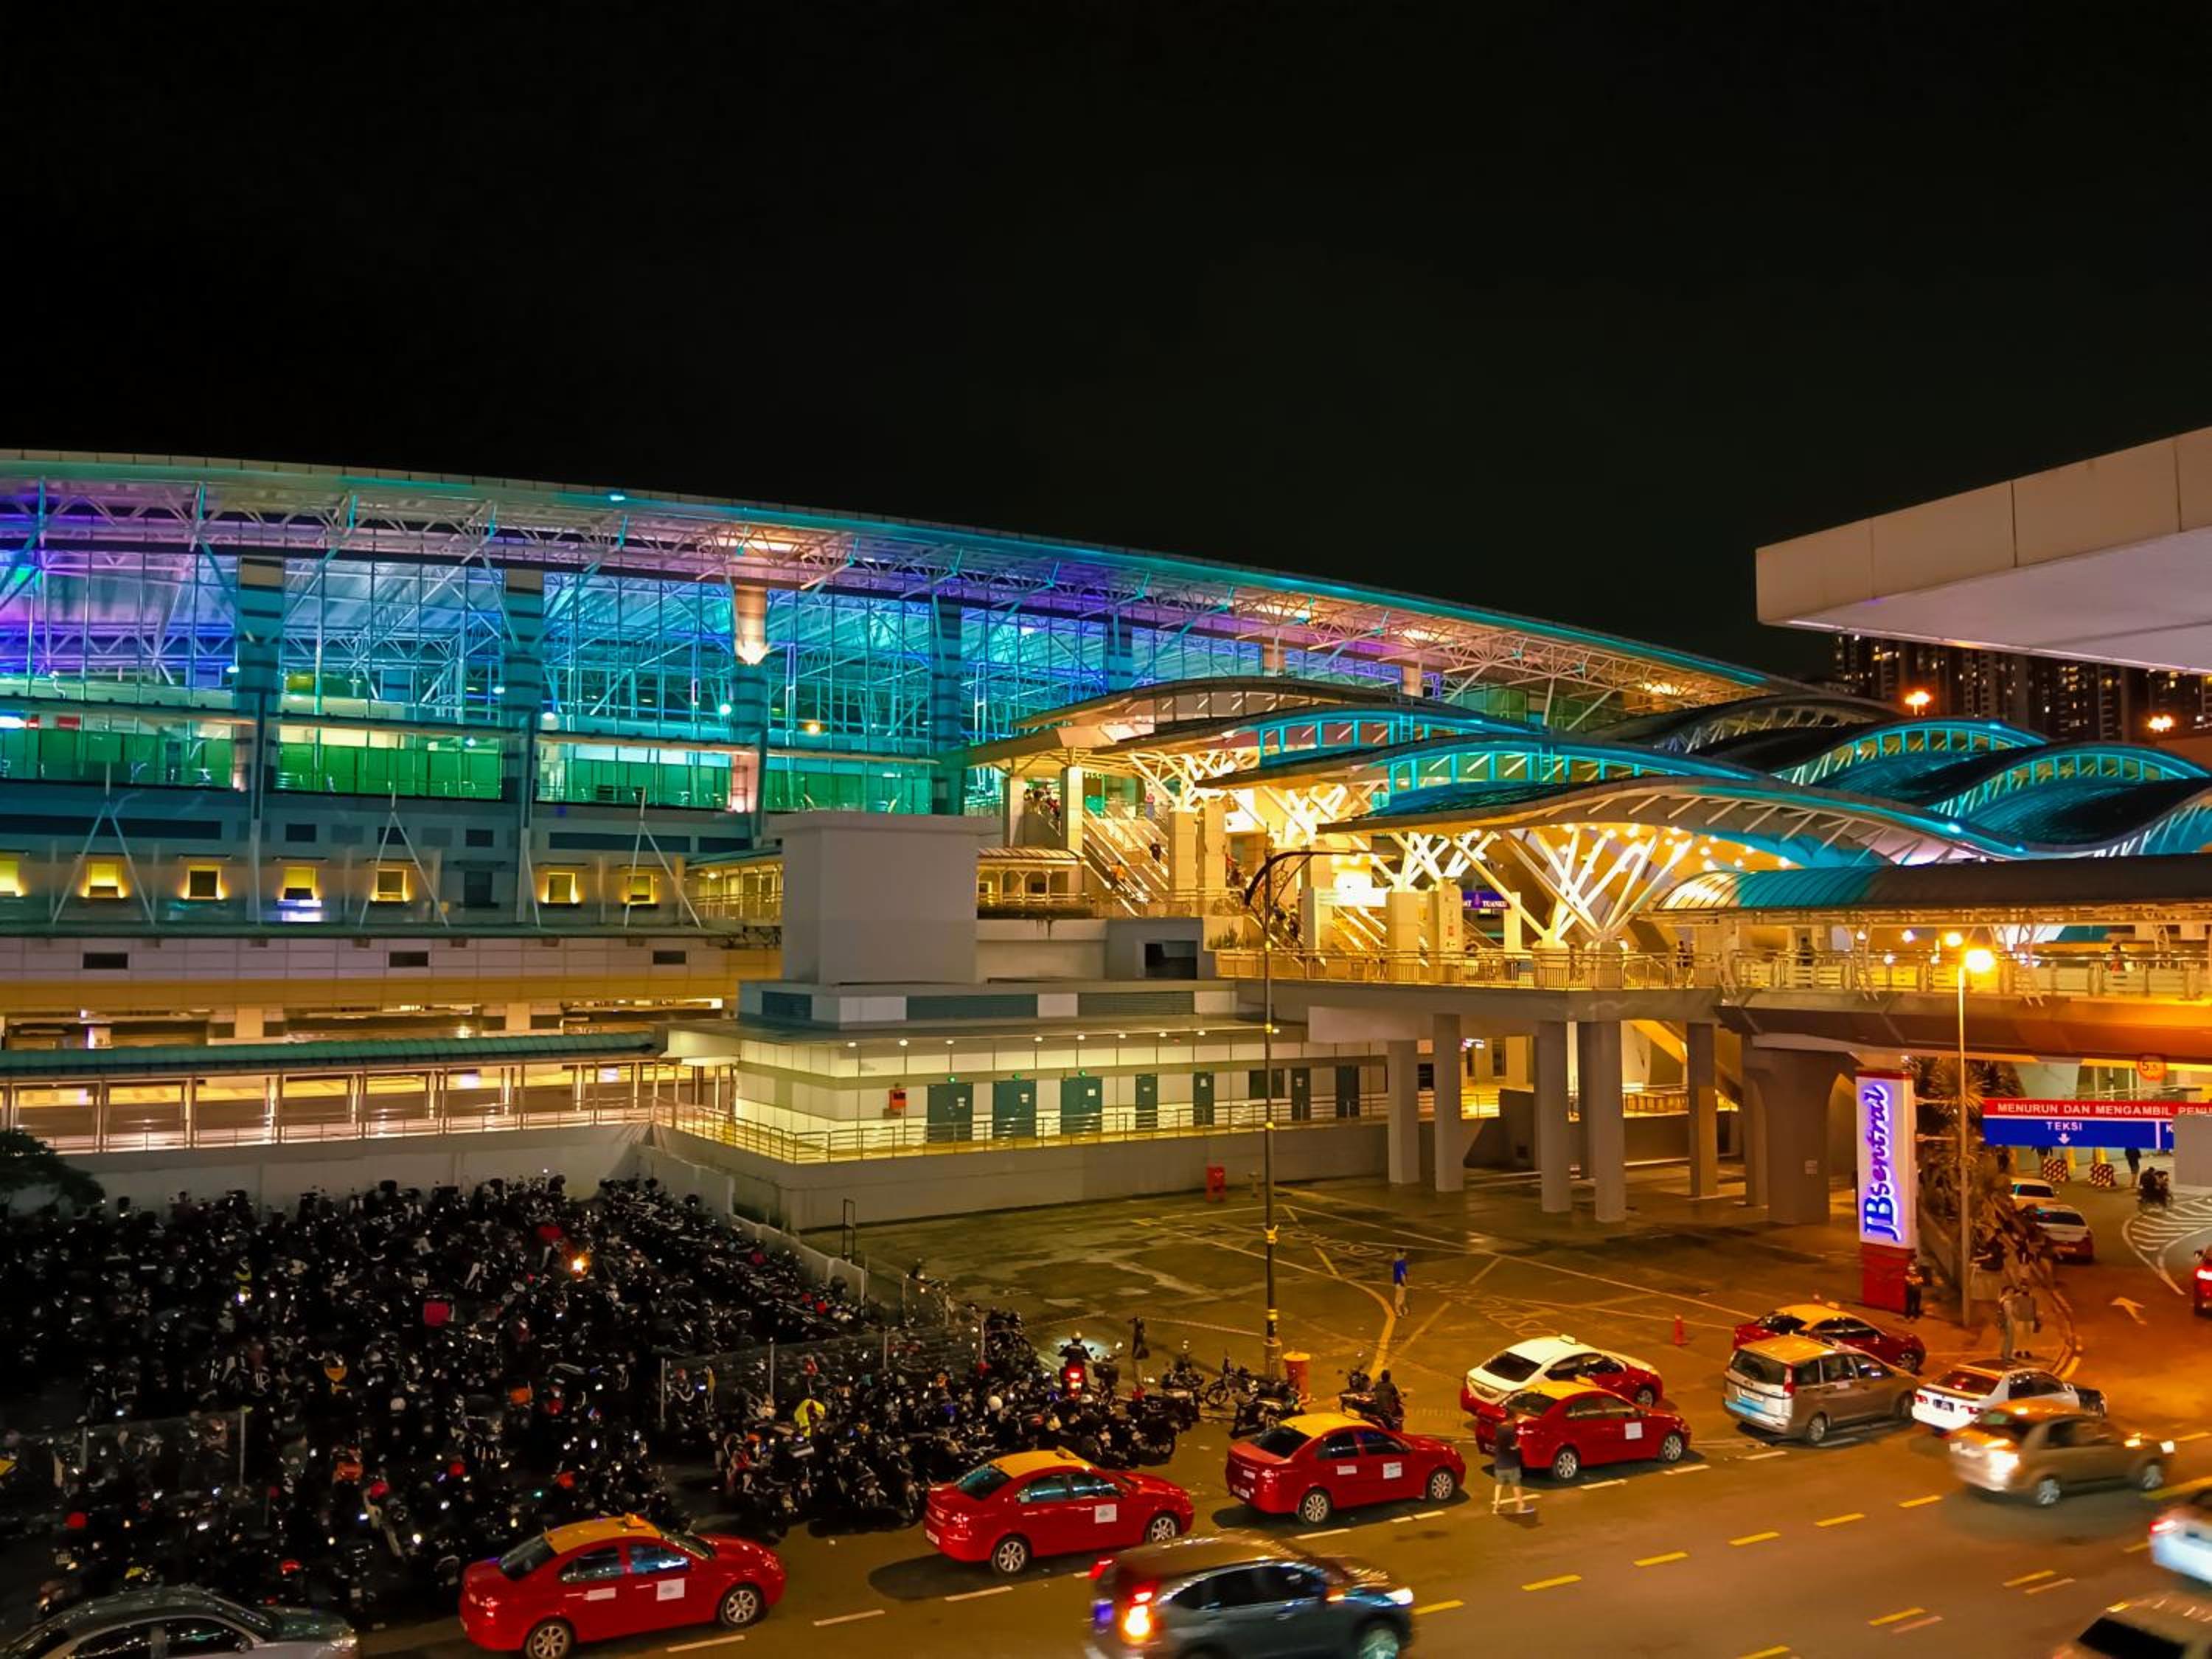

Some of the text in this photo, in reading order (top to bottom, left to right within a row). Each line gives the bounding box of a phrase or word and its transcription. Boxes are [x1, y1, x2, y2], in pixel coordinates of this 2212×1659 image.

[1997, 1103, 2059, 1114] MENURUN
[2064, 1105, 2090, 1114] DAN
[2095, 1105, 2173, 1116] MENGAMBIL
[2045, 1121, 2083, 1131] TEKSI
